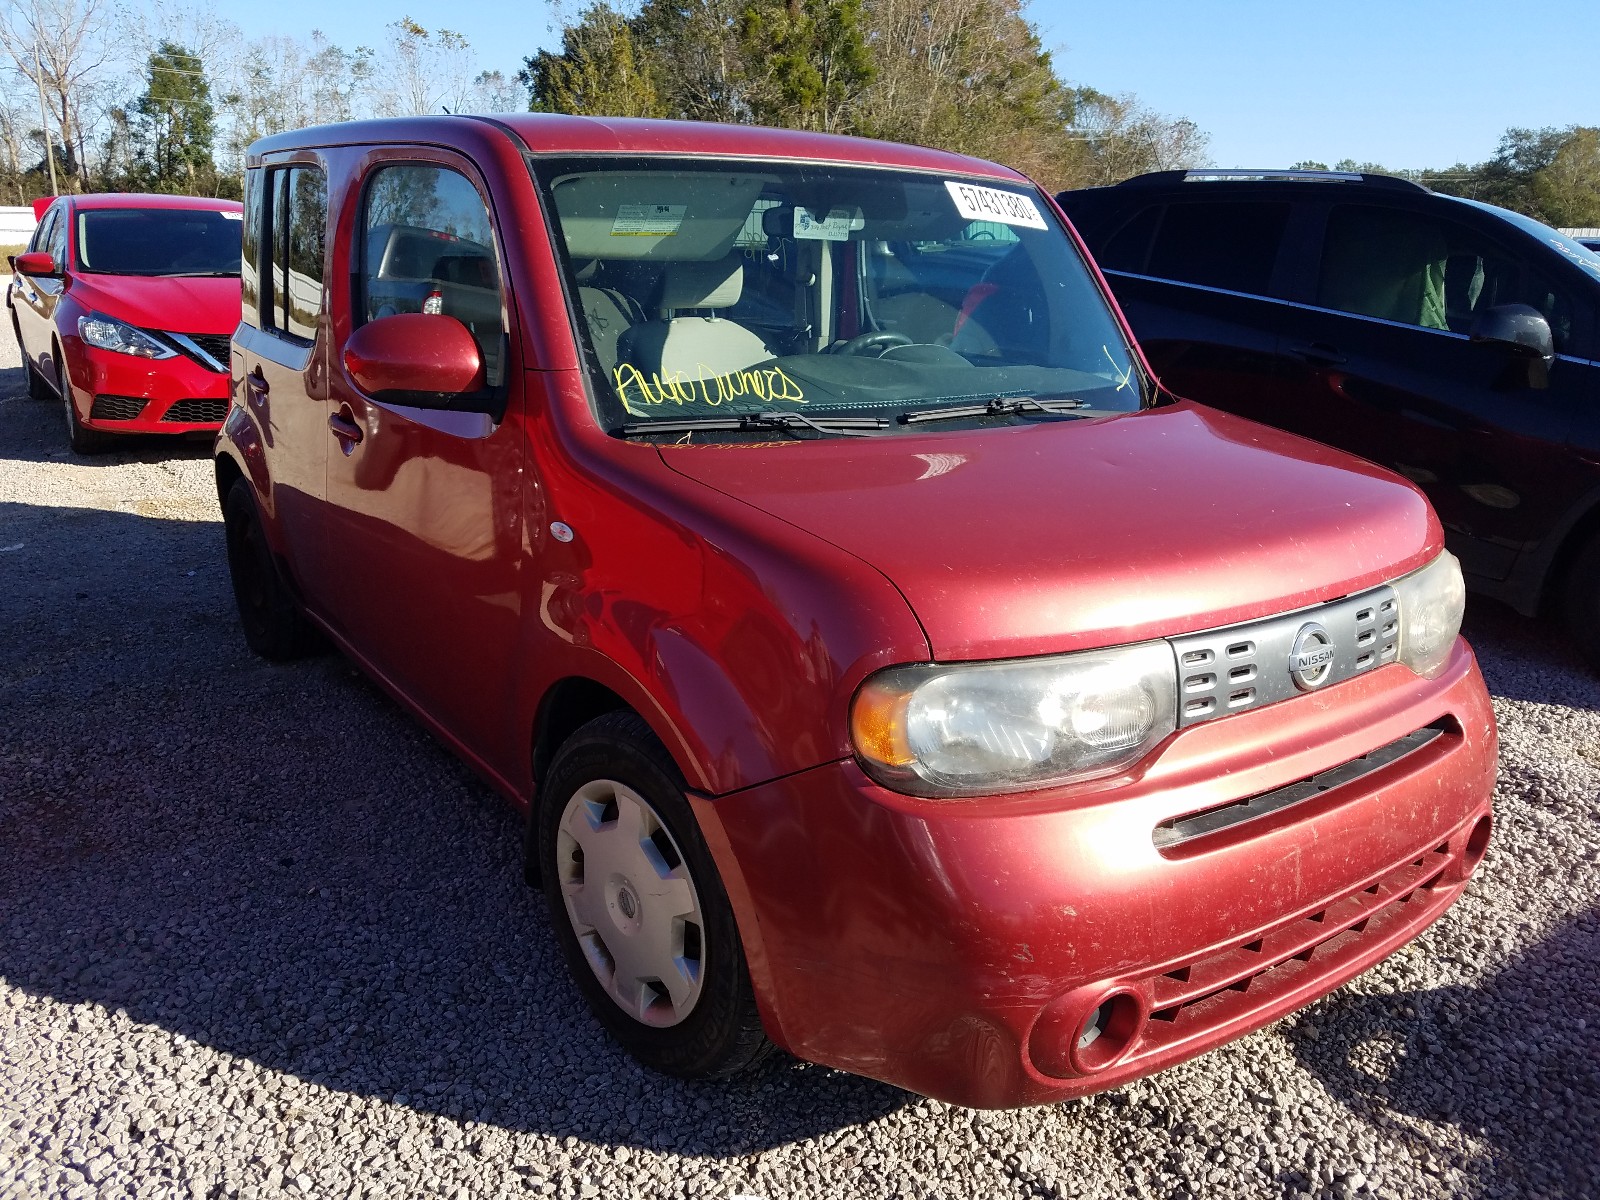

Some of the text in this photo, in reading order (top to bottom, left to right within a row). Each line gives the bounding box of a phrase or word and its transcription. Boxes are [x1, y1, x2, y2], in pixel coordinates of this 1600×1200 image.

[959, 186, 1032, 220] 57431380
[613, 363, 696, 414] Auto
[1298, 650, 1335, 667] NISSAN
